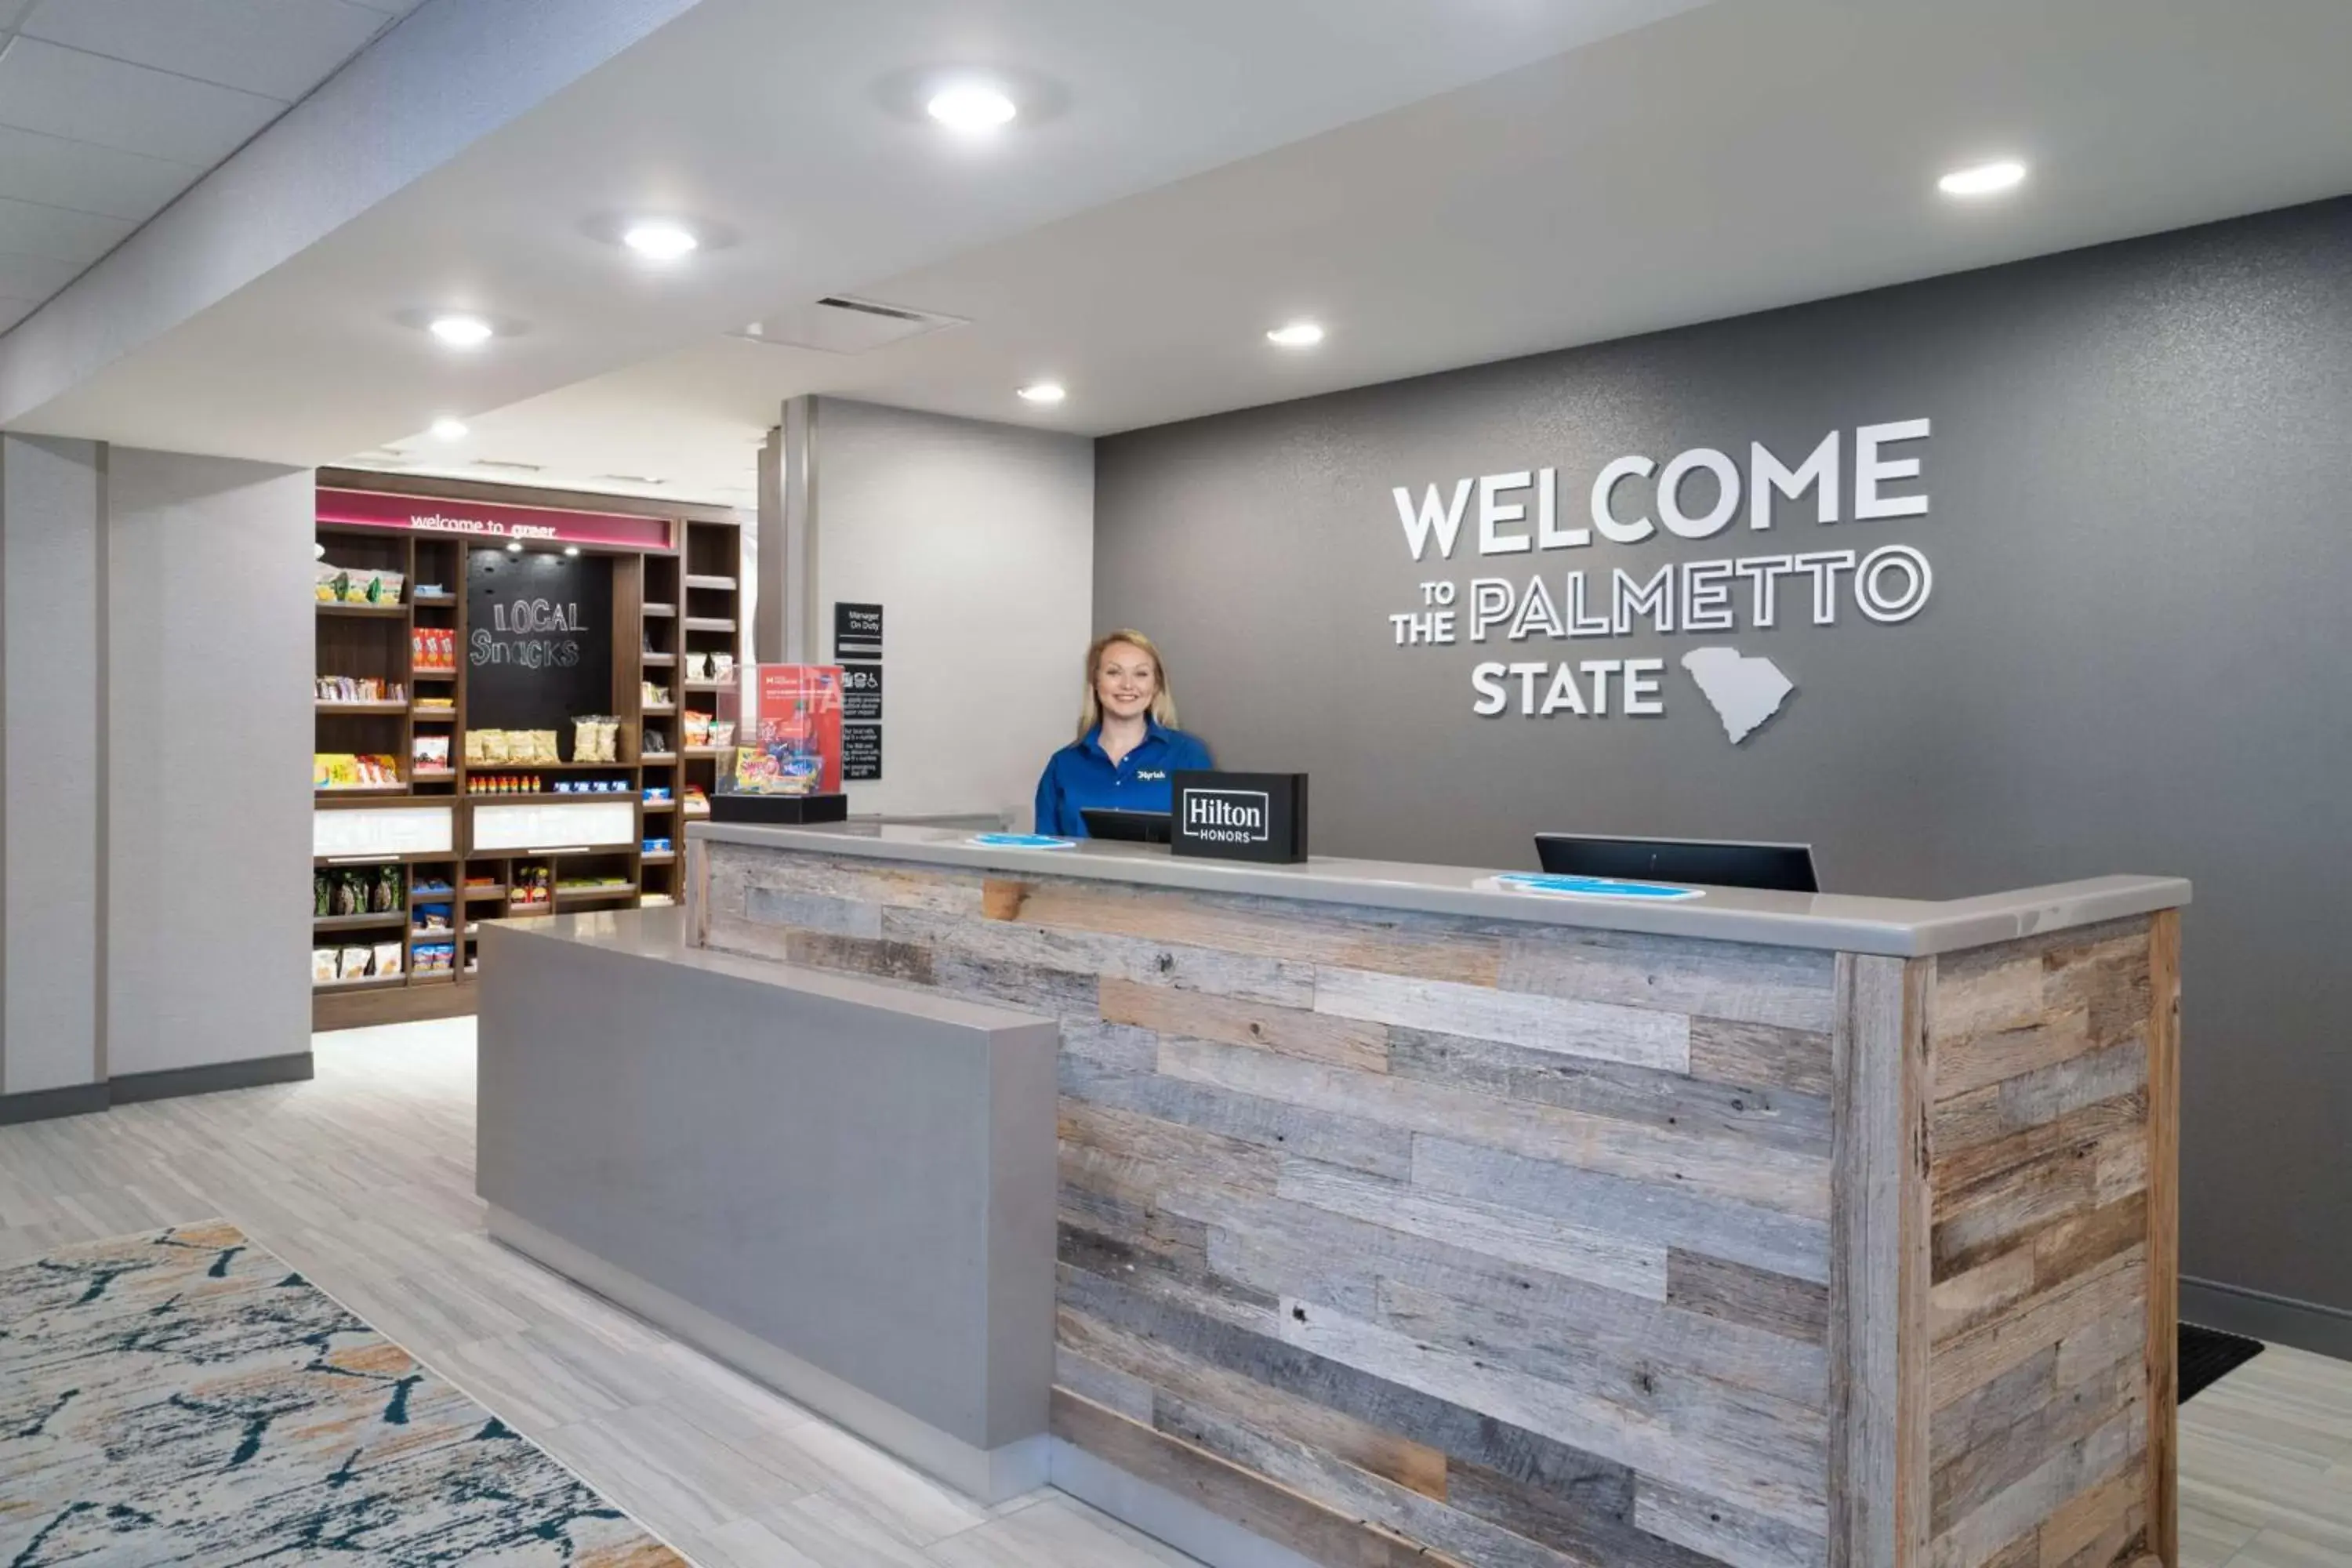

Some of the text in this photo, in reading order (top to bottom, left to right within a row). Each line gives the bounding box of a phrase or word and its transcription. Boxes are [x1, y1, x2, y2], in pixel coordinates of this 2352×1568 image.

[1392, 418, 1930, 561] WELCOME
[411, 514, 483, 532] welcome
[487, 520, 504, 535] to
[1388, 544, 1933, 644] THE PALMETTO
[1420, 581, 1455, 605] TO
[493, 597, 590, 634] LOCAL
[849, 612, 880, 622] Manager
[851, 620, 880, 633] On Duty
[1472, 658, 1664, 715] STATE
[1190, 797, 1261, 828] Hilton
[1200, 829, 1251, 844] HONORS
